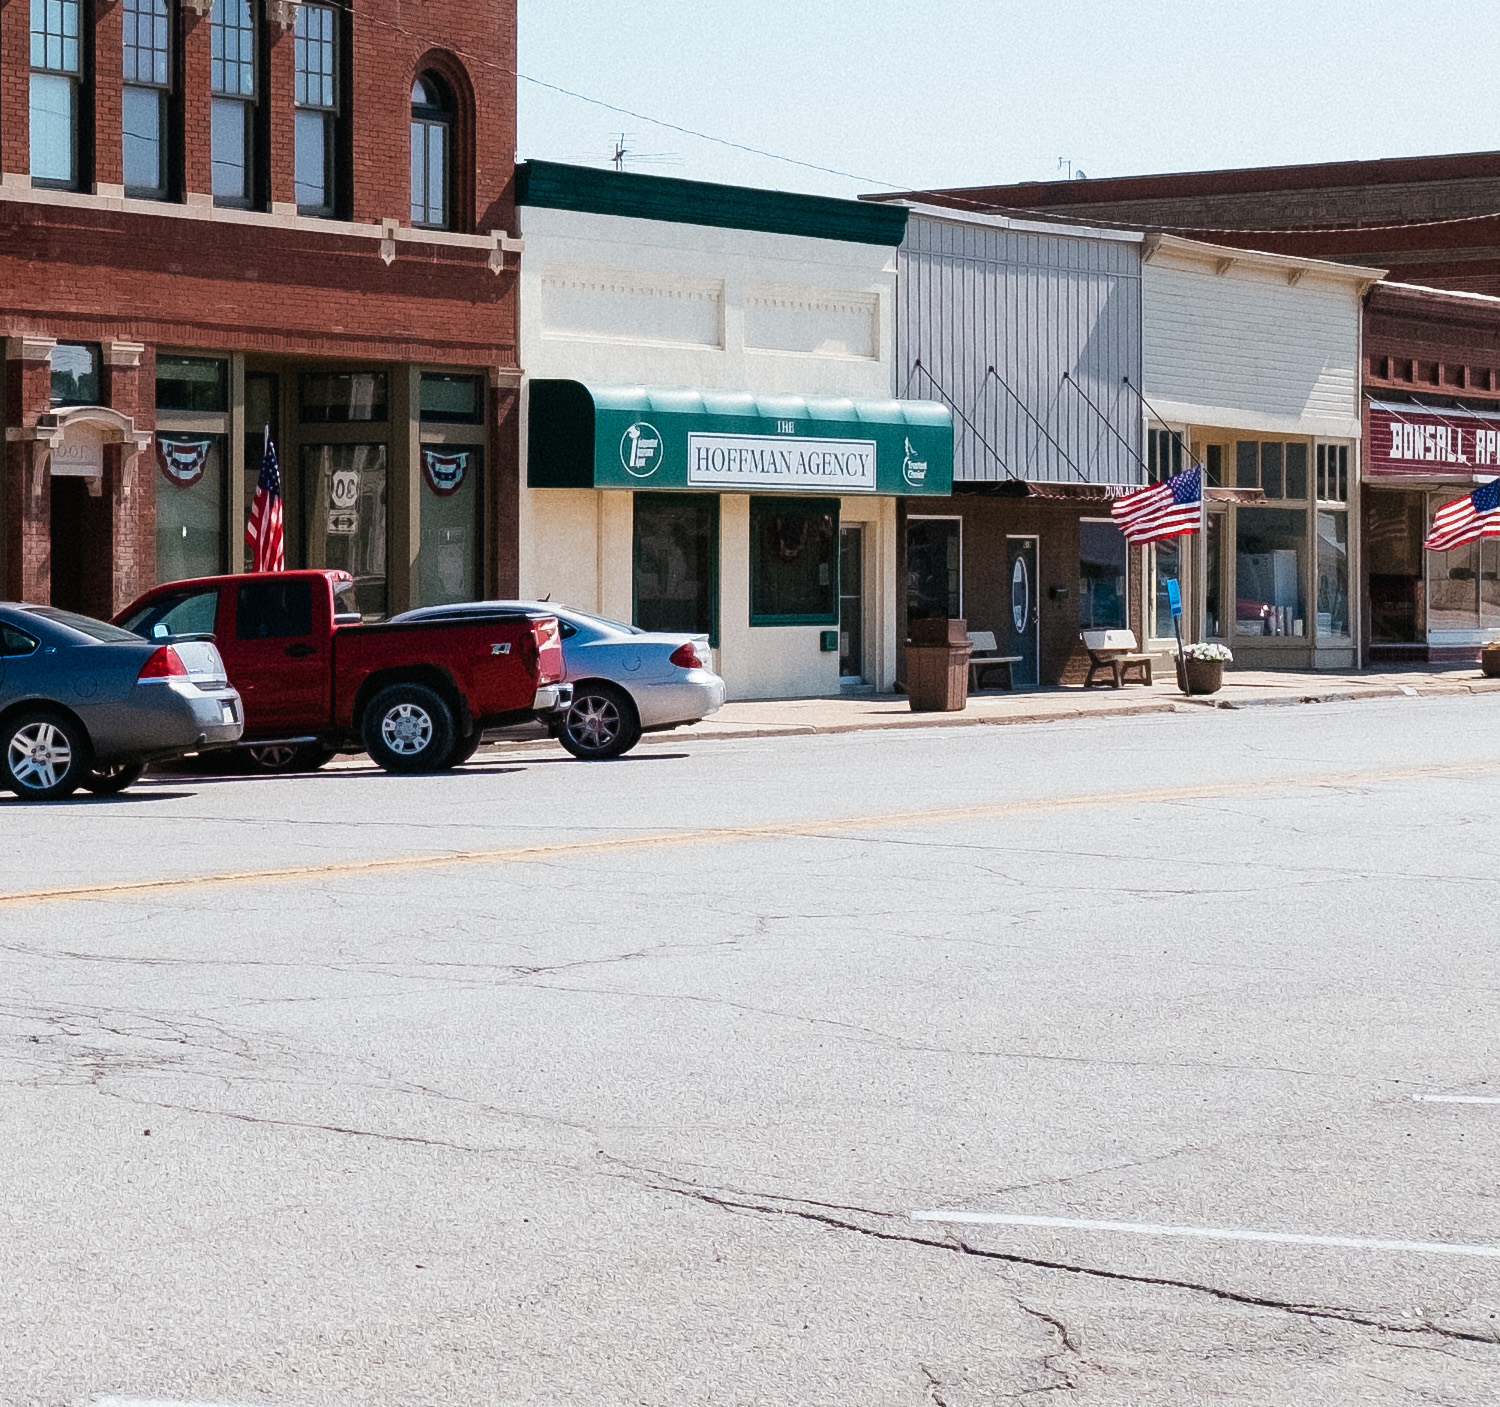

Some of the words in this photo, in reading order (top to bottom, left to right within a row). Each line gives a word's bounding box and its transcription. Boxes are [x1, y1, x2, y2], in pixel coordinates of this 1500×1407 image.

[777, 421, 795, 434] THE
[1389, 423, 1467, 463] BONSALL
[695, 446, 792, 474] HOFFMAN
[796, 450, 870, 478] AGENCY
